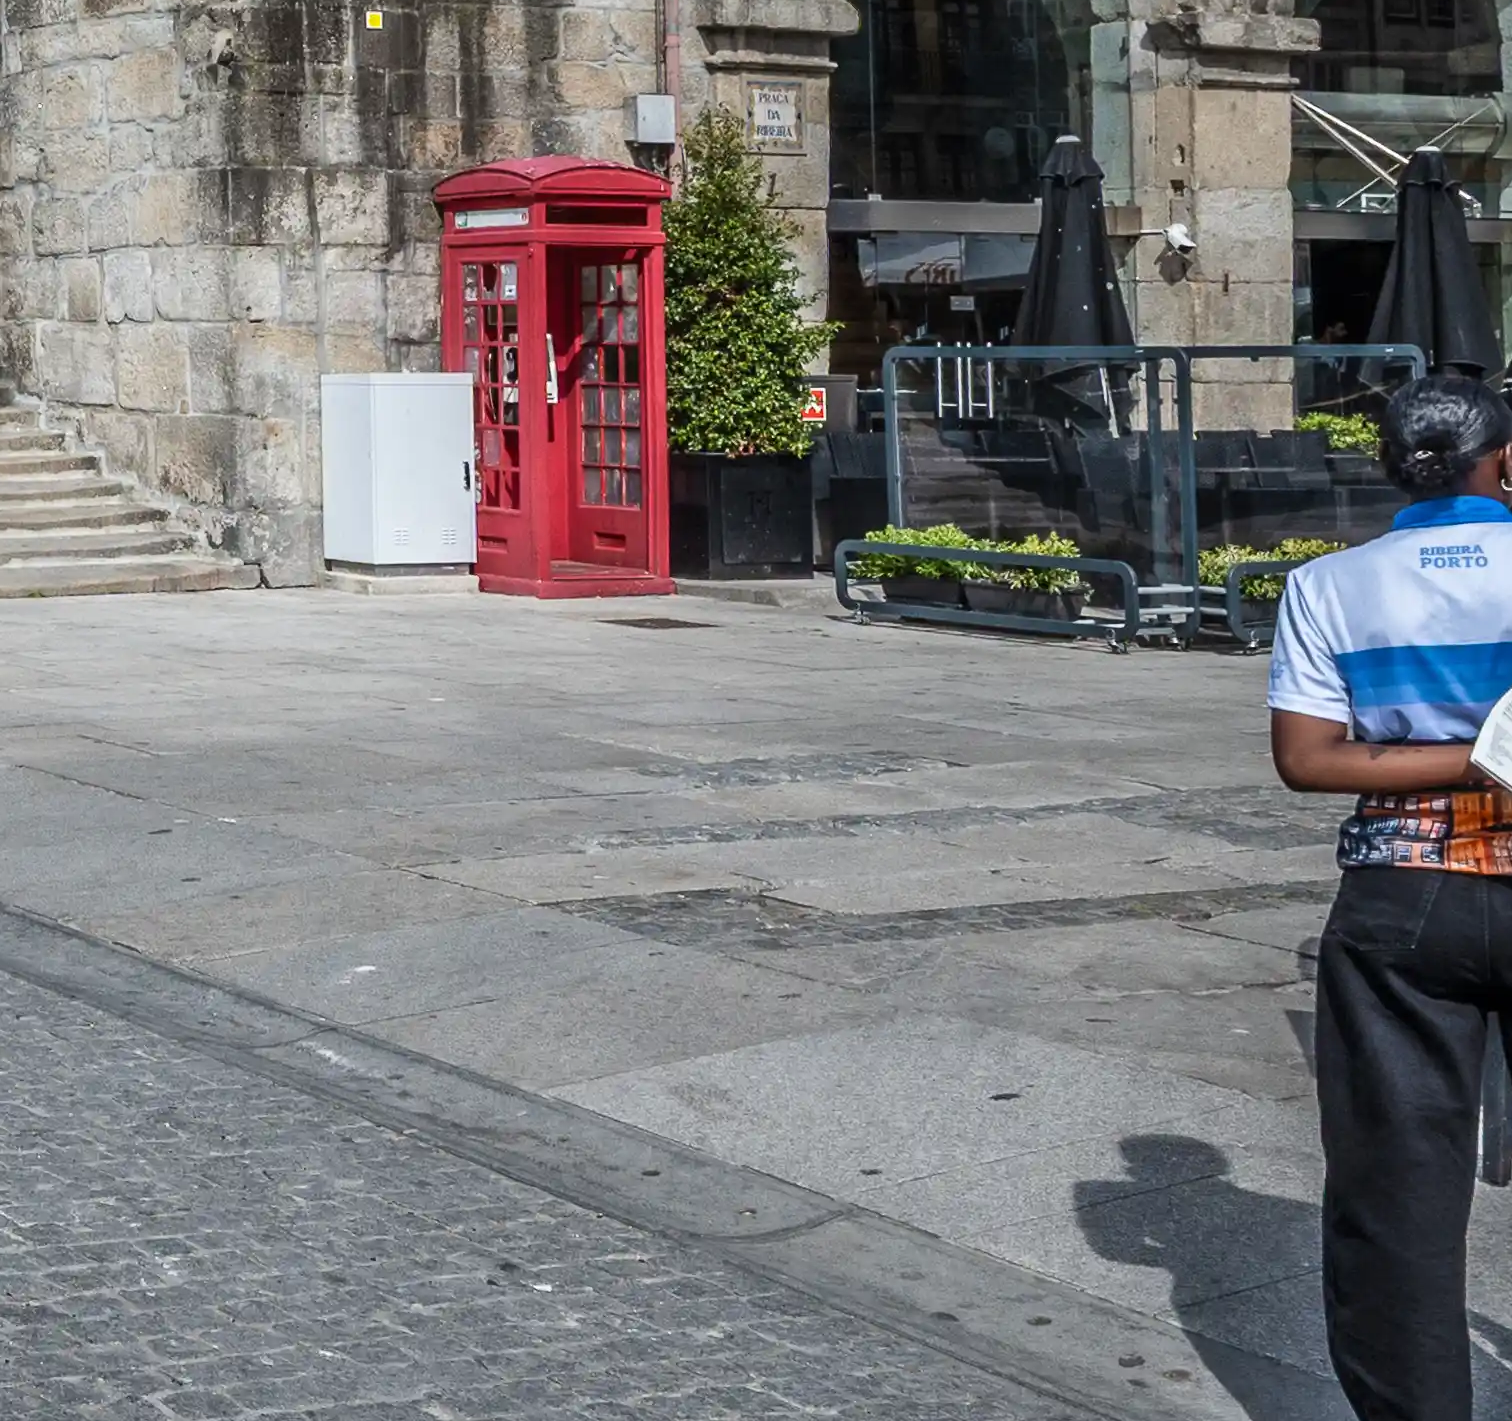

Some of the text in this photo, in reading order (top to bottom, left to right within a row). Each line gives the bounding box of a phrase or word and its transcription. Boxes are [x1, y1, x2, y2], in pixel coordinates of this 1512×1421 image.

[767, 109, 781, 121] DA
[1419, 544, 1485, 556] RIBEIRA
[1419, 556, 1488, 569] PORTO
